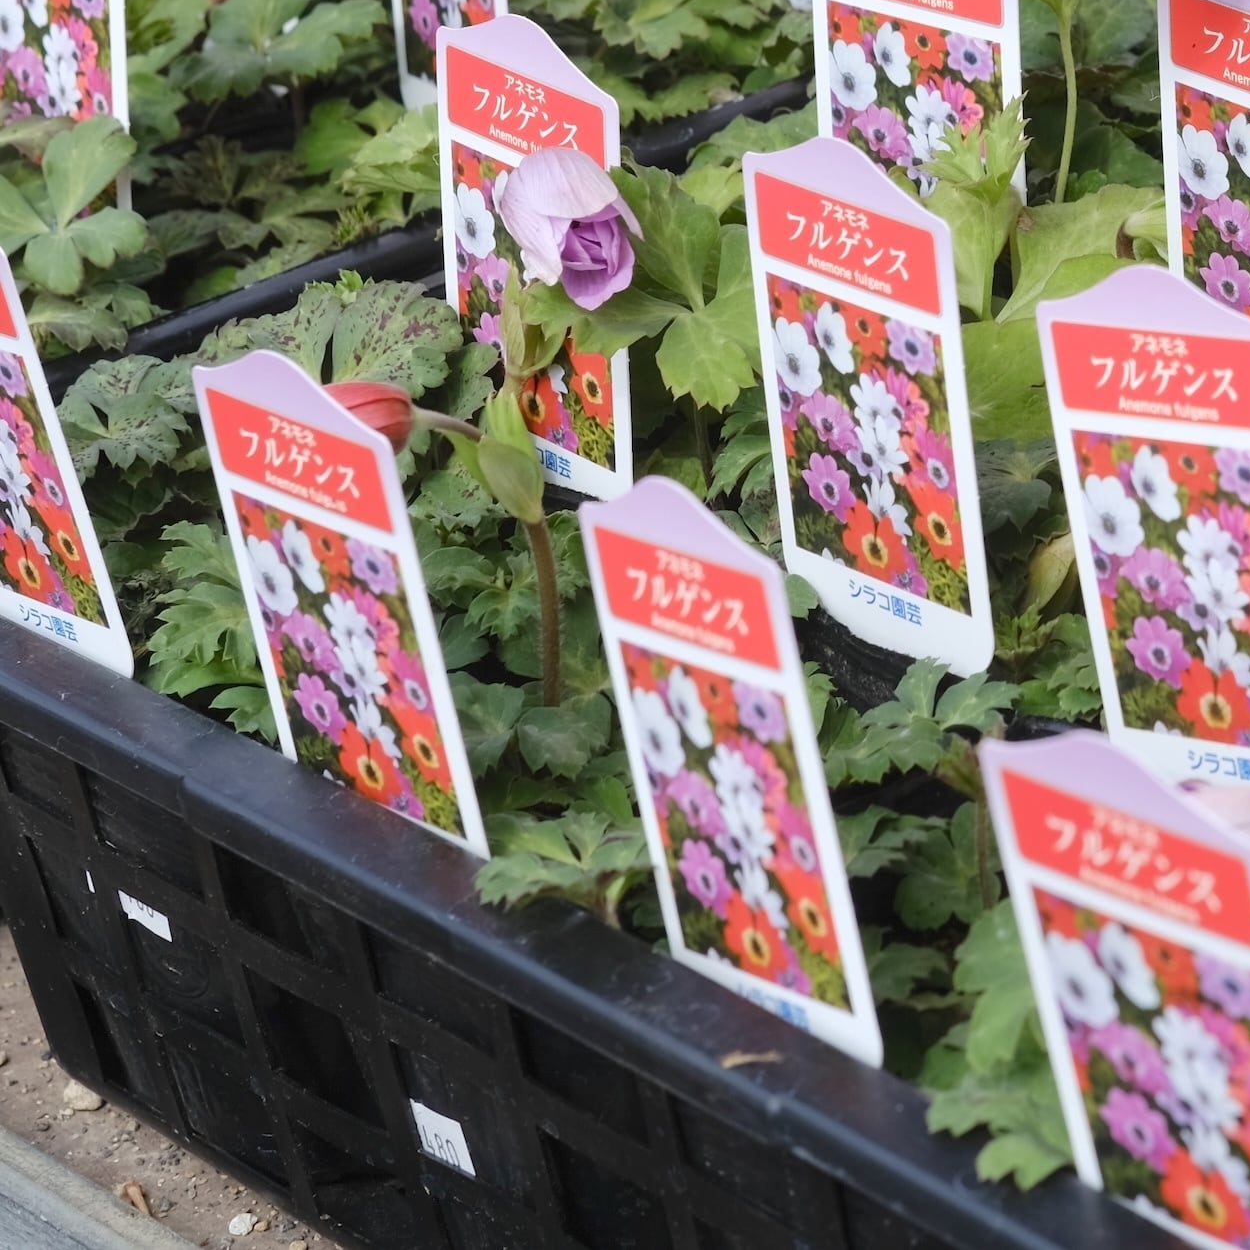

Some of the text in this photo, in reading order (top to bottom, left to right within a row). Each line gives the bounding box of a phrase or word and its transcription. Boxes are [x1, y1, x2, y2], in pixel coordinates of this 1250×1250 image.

[504, 73, 547, 105] アネモネ
[472, 83, 579, 151] フルゲンス
[488, 123, 529, 151] Anemone
[820, 199, 870, 231] アネモネ
[786, 211, 909, 281] フルゲンス
[807, 253, 892, 295] Anemone fulgens
[1130, 334, 1188, 358] アネモネ
[1091, 356, 1237, 401] フルゲンス
[1118, 396, 1219, 421] Anemone fulgens
[268, 415, 317, 448] アネモネ
[239, 427, 360, 499] フルゲンス
[626, 567, 748, 635] フルゲンス
[848, 579, 922, 626] シラコ園芸
[19, 604, 78, 642] シラコ園芸
